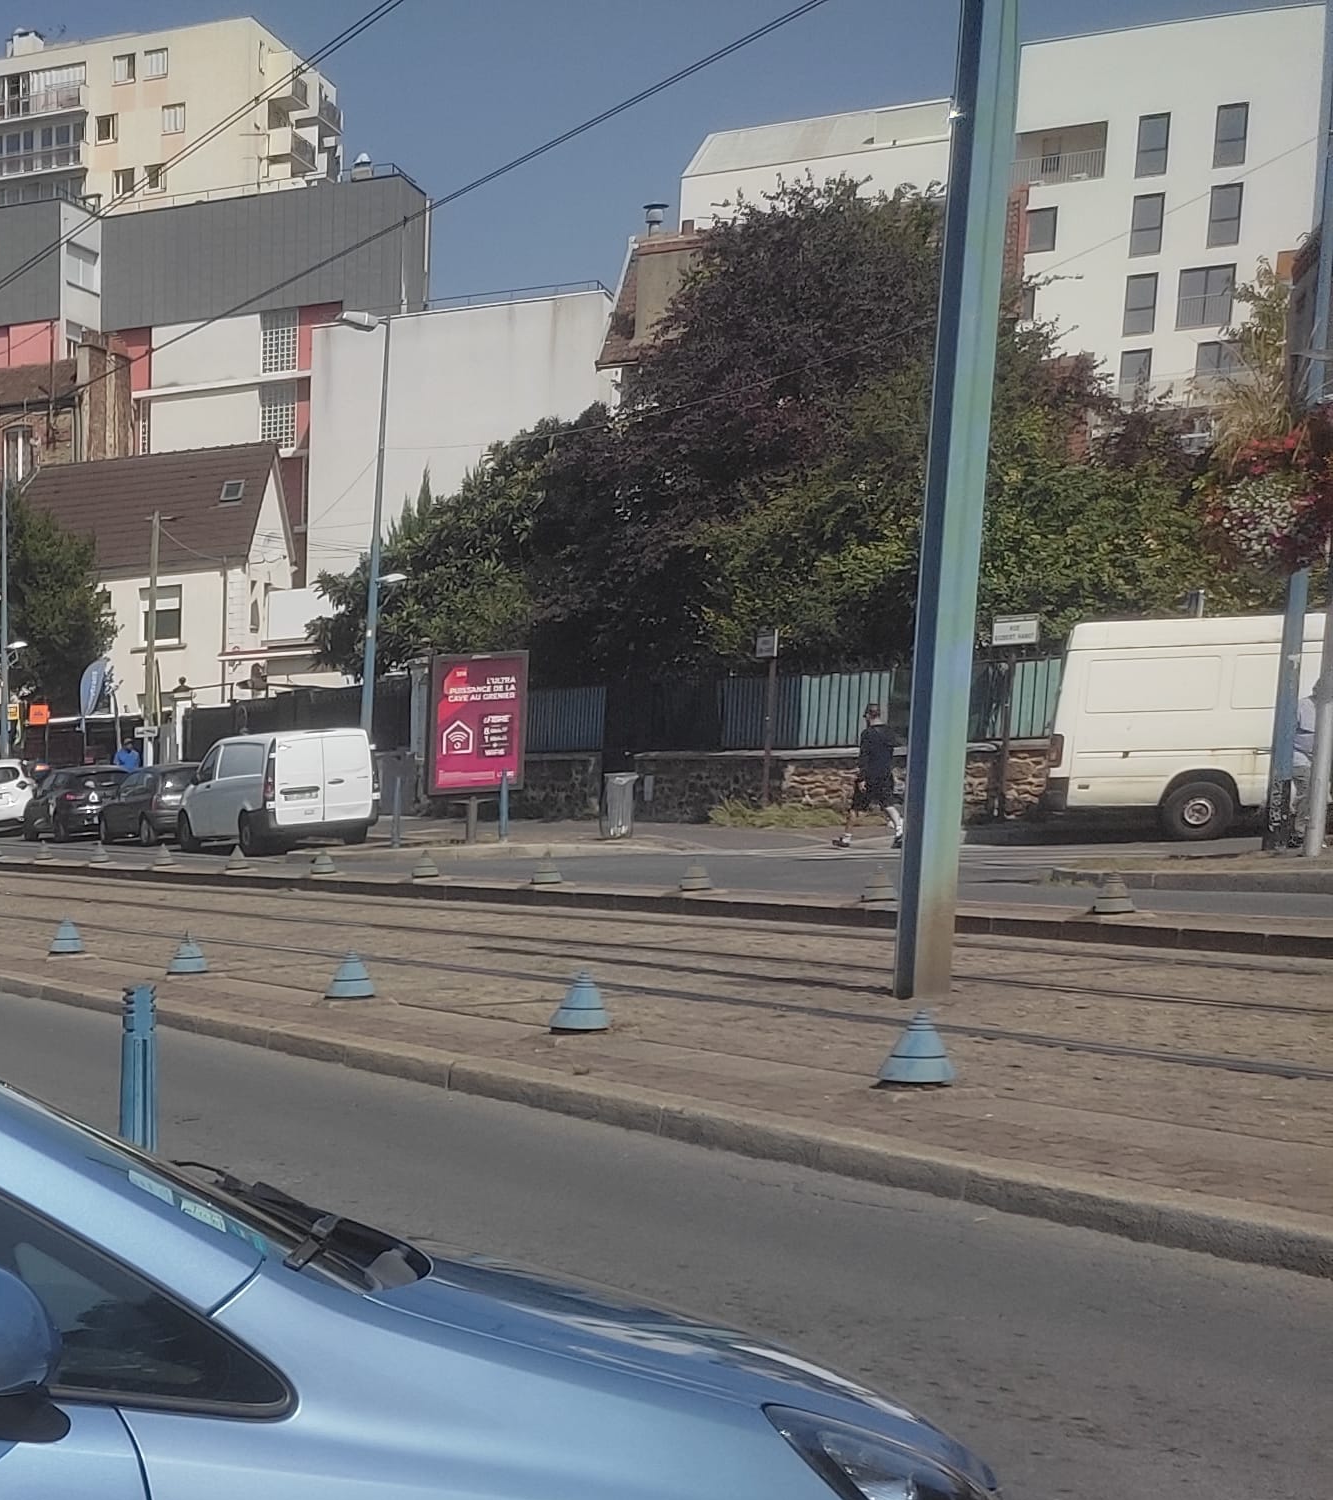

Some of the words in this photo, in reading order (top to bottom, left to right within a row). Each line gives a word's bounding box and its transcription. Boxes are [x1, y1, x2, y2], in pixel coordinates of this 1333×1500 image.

[486, 676, 516, 685] L'ULTRA
[493, 684, 504, 692] DE
[505, 684, 517, 692] LA
[448, 694, 469, 702] CAVE
[470, 693, 481, 701] AU
[482, 692, 516, 700] GRENIER
